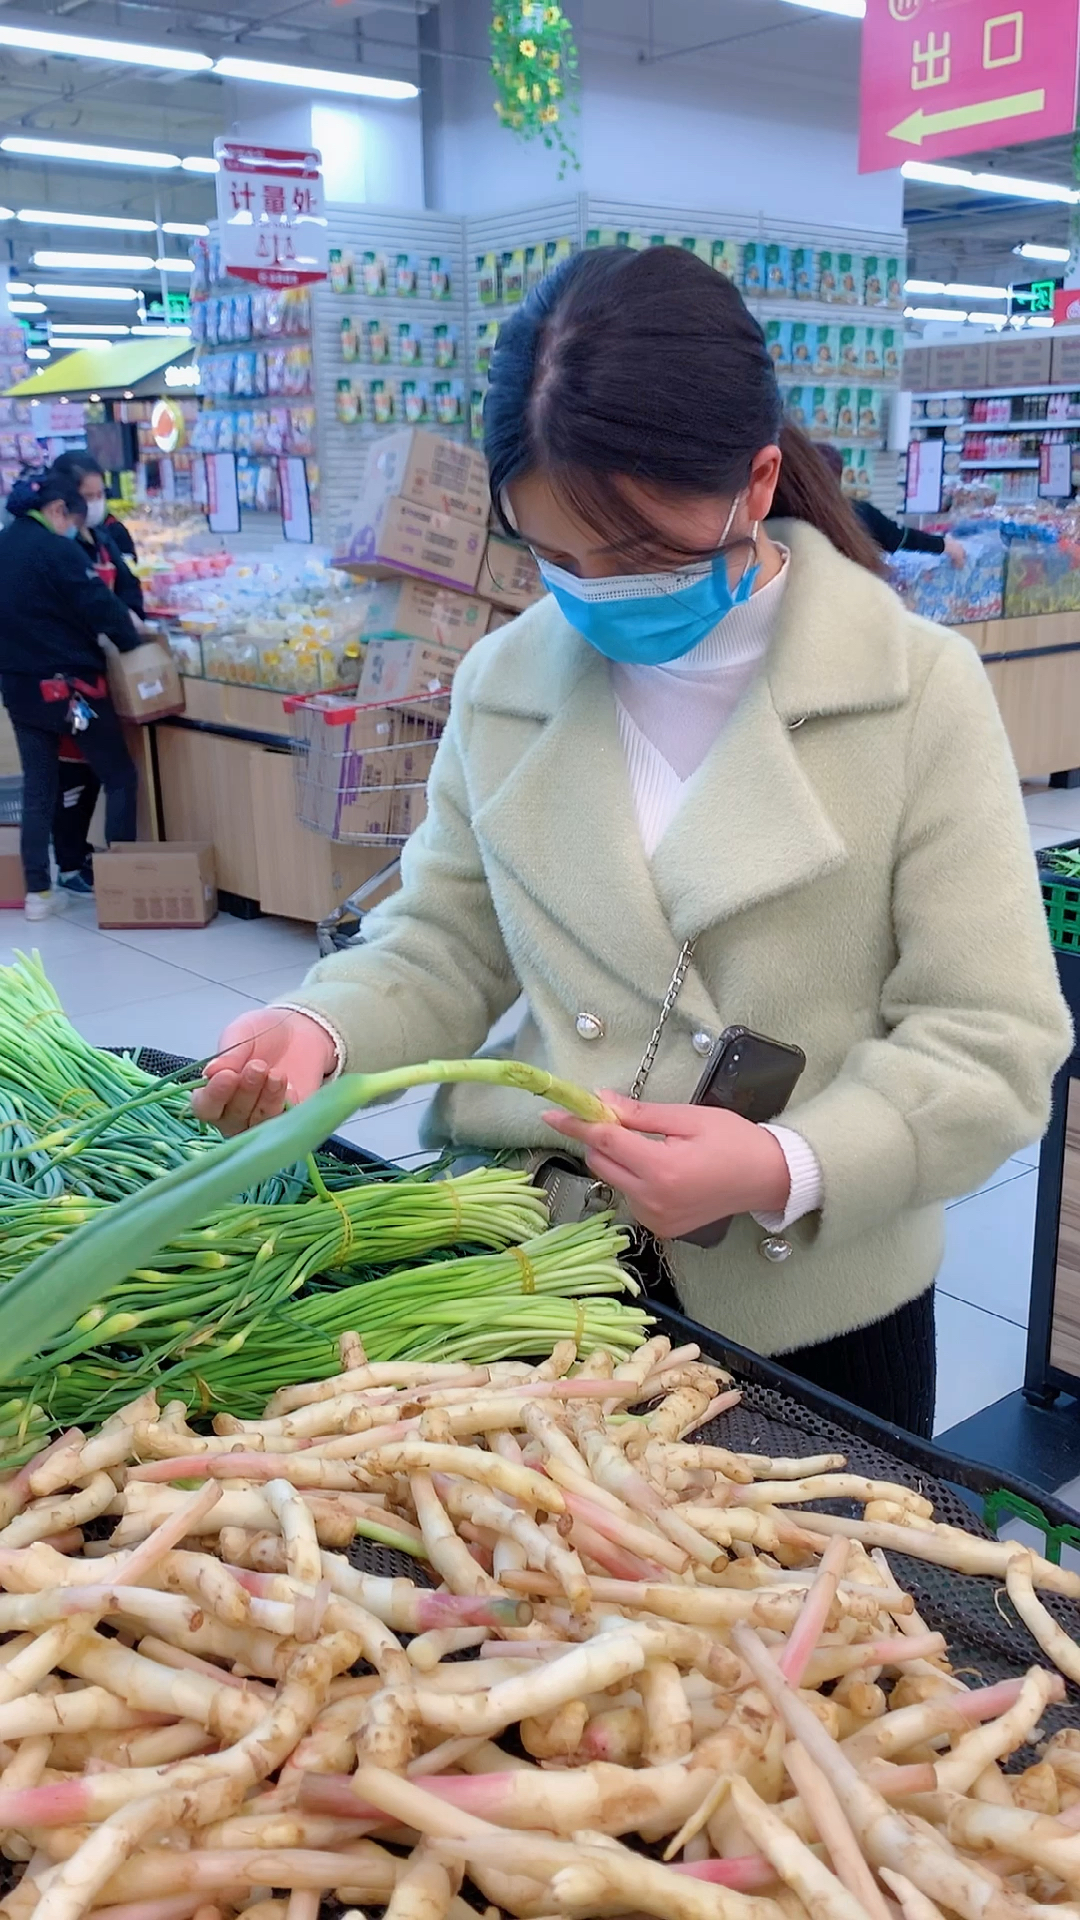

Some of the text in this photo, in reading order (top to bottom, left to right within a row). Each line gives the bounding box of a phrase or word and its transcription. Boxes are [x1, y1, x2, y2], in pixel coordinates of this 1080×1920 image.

[911, 11, 1023, 90] 出口
[229, 181, 317, 214] 计量处
